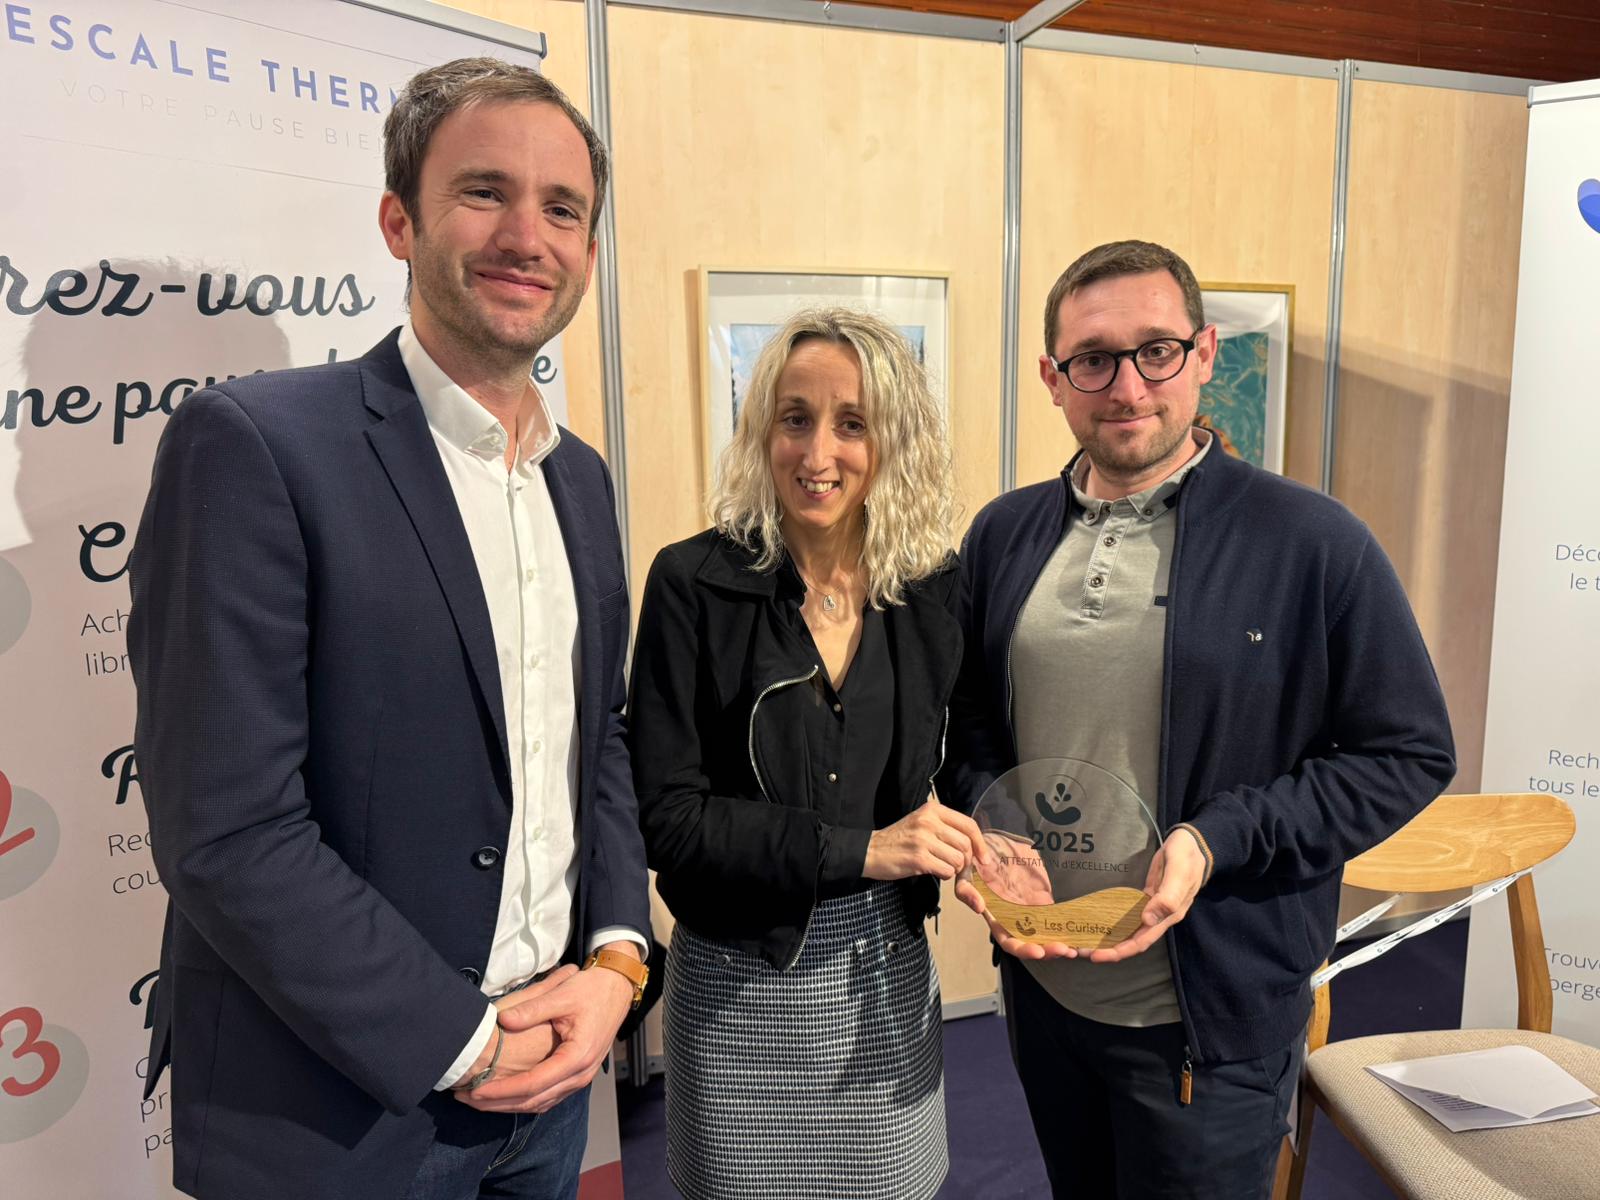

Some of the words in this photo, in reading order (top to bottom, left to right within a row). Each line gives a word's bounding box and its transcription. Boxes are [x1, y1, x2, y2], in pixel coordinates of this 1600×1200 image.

[6, 4, 230, 84] ESCALE
[61, 78, 178, 118] VOTRE
[205, 104, 305, 139] PAUSE
[1555, 544, 1600, 562] Déc
[1570, 572, 1587, 590] le
[1548, 749, 1600, 769] Rech
[1529, 775, 1575, 795] tous
[1030, 830, 1095, 853] 2025
[1044, 919, 1063, 932] Les
[1065, 920, 1113, 936] Curistes
[1544, 947, 1600, 970] rouv
